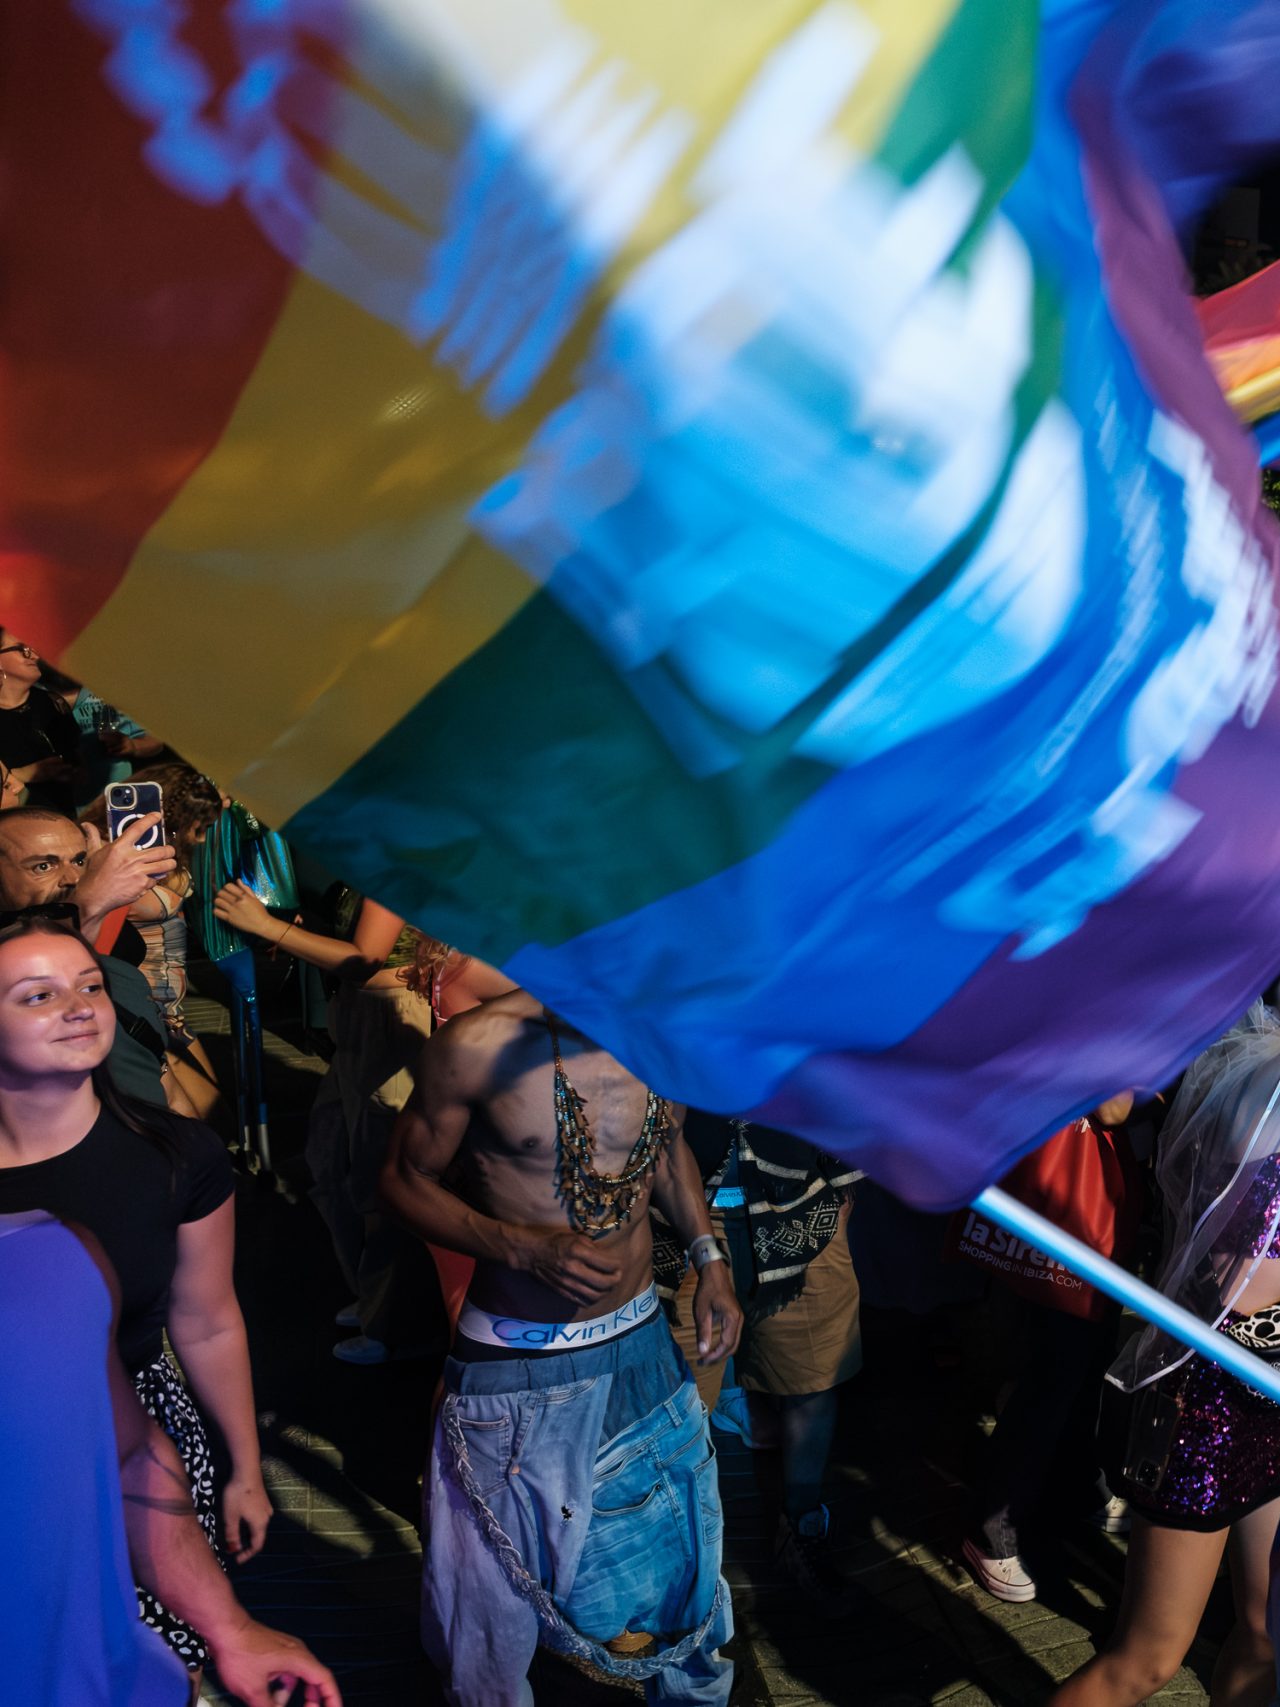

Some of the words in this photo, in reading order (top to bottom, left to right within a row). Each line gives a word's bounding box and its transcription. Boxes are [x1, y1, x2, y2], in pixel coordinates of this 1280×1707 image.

[961, 1212, 990, 1246] la
[492, 1319, 606, 1344] Calvin
[613, 1284, 658, 1329] Klei
